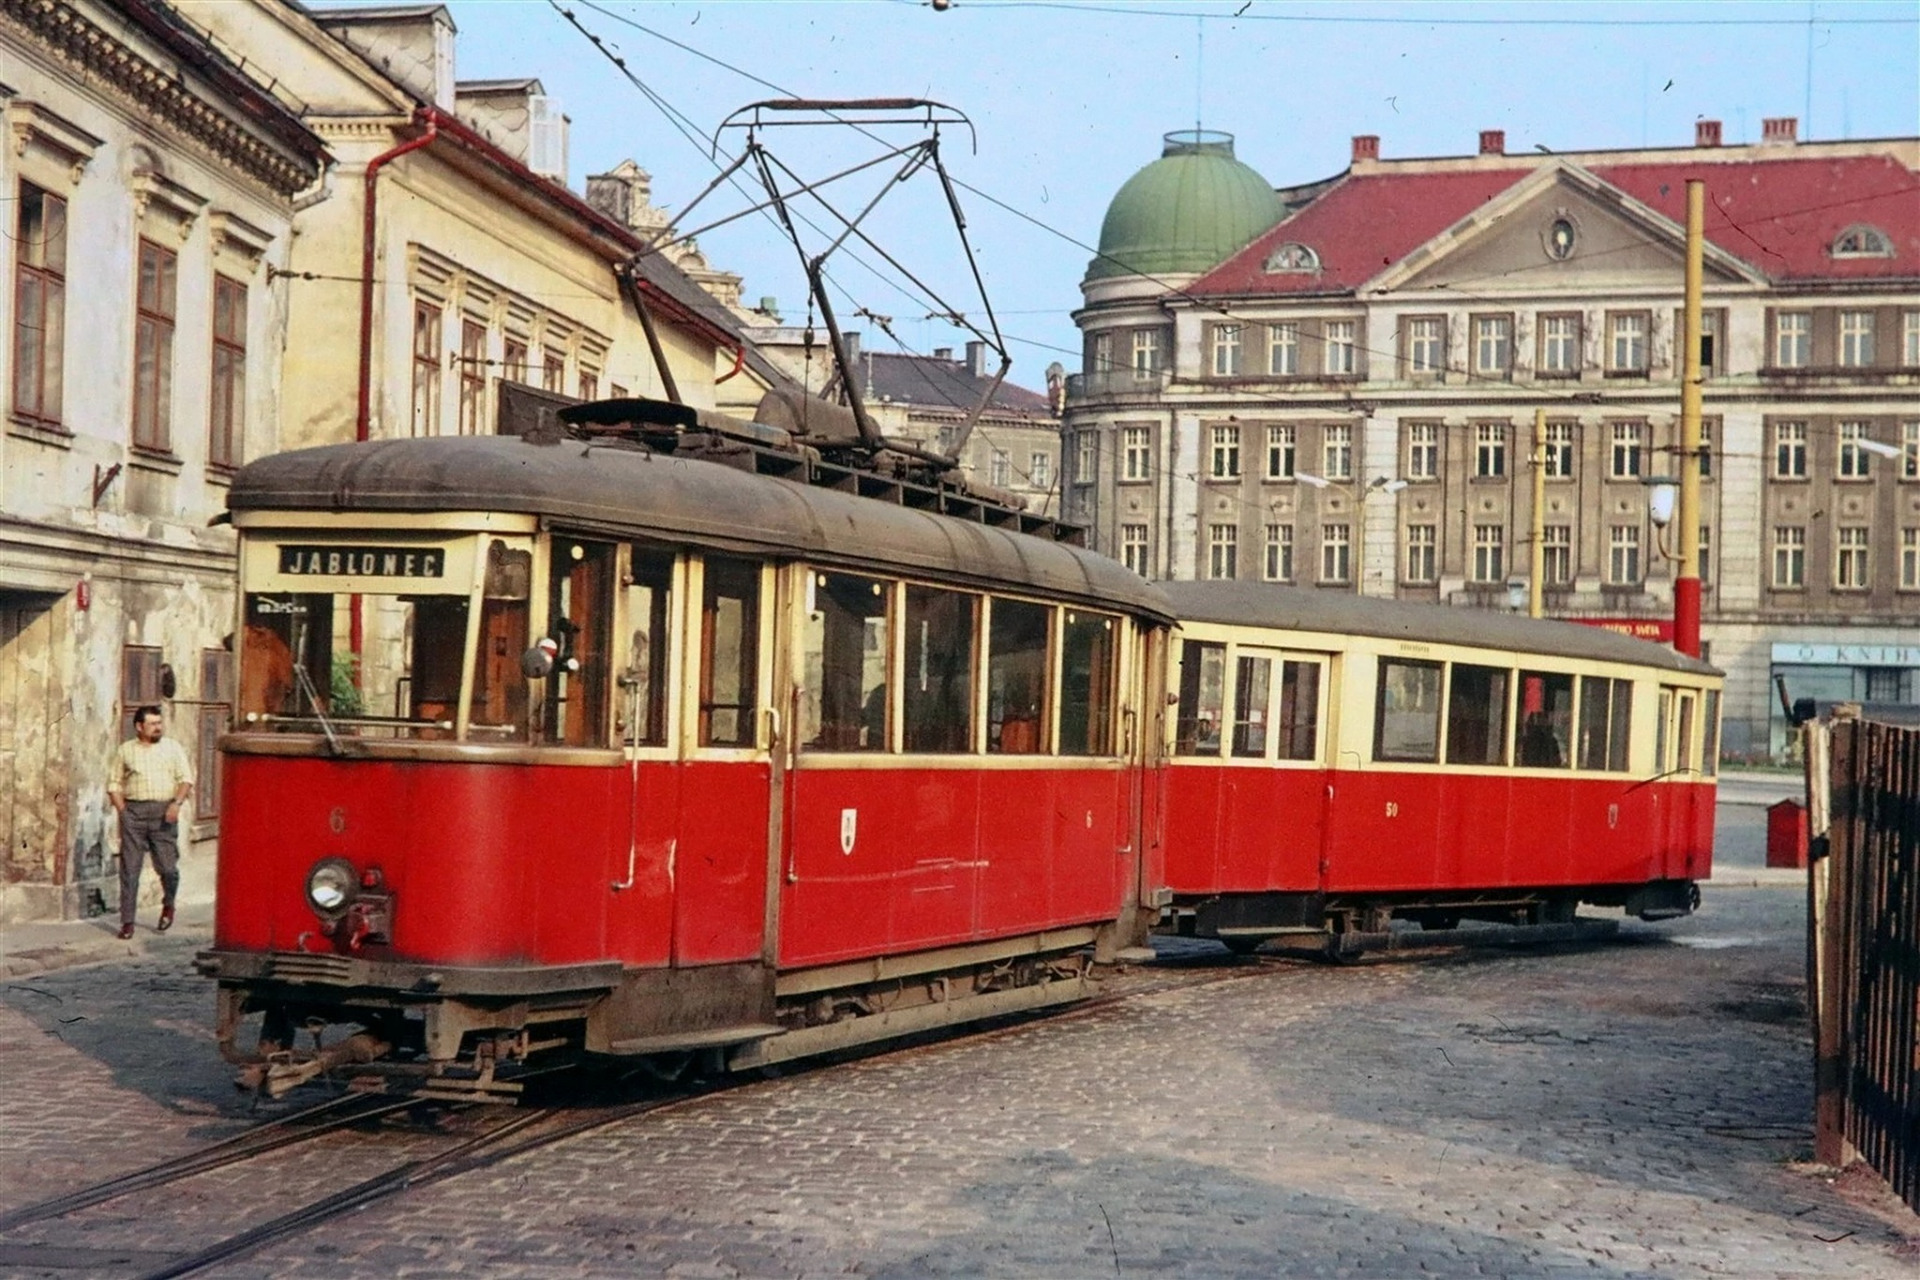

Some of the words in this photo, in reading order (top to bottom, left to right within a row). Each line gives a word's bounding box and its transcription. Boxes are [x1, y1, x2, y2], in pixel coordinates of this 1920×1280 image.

[289, 551, 436, 577] JABLONEC
[1837, 647, 1920, 662] KNIH
[1086, 809, 1093, 828] 6
[1386, 801, 1398, 817] 50
[329, 806, 345, 833] 6
